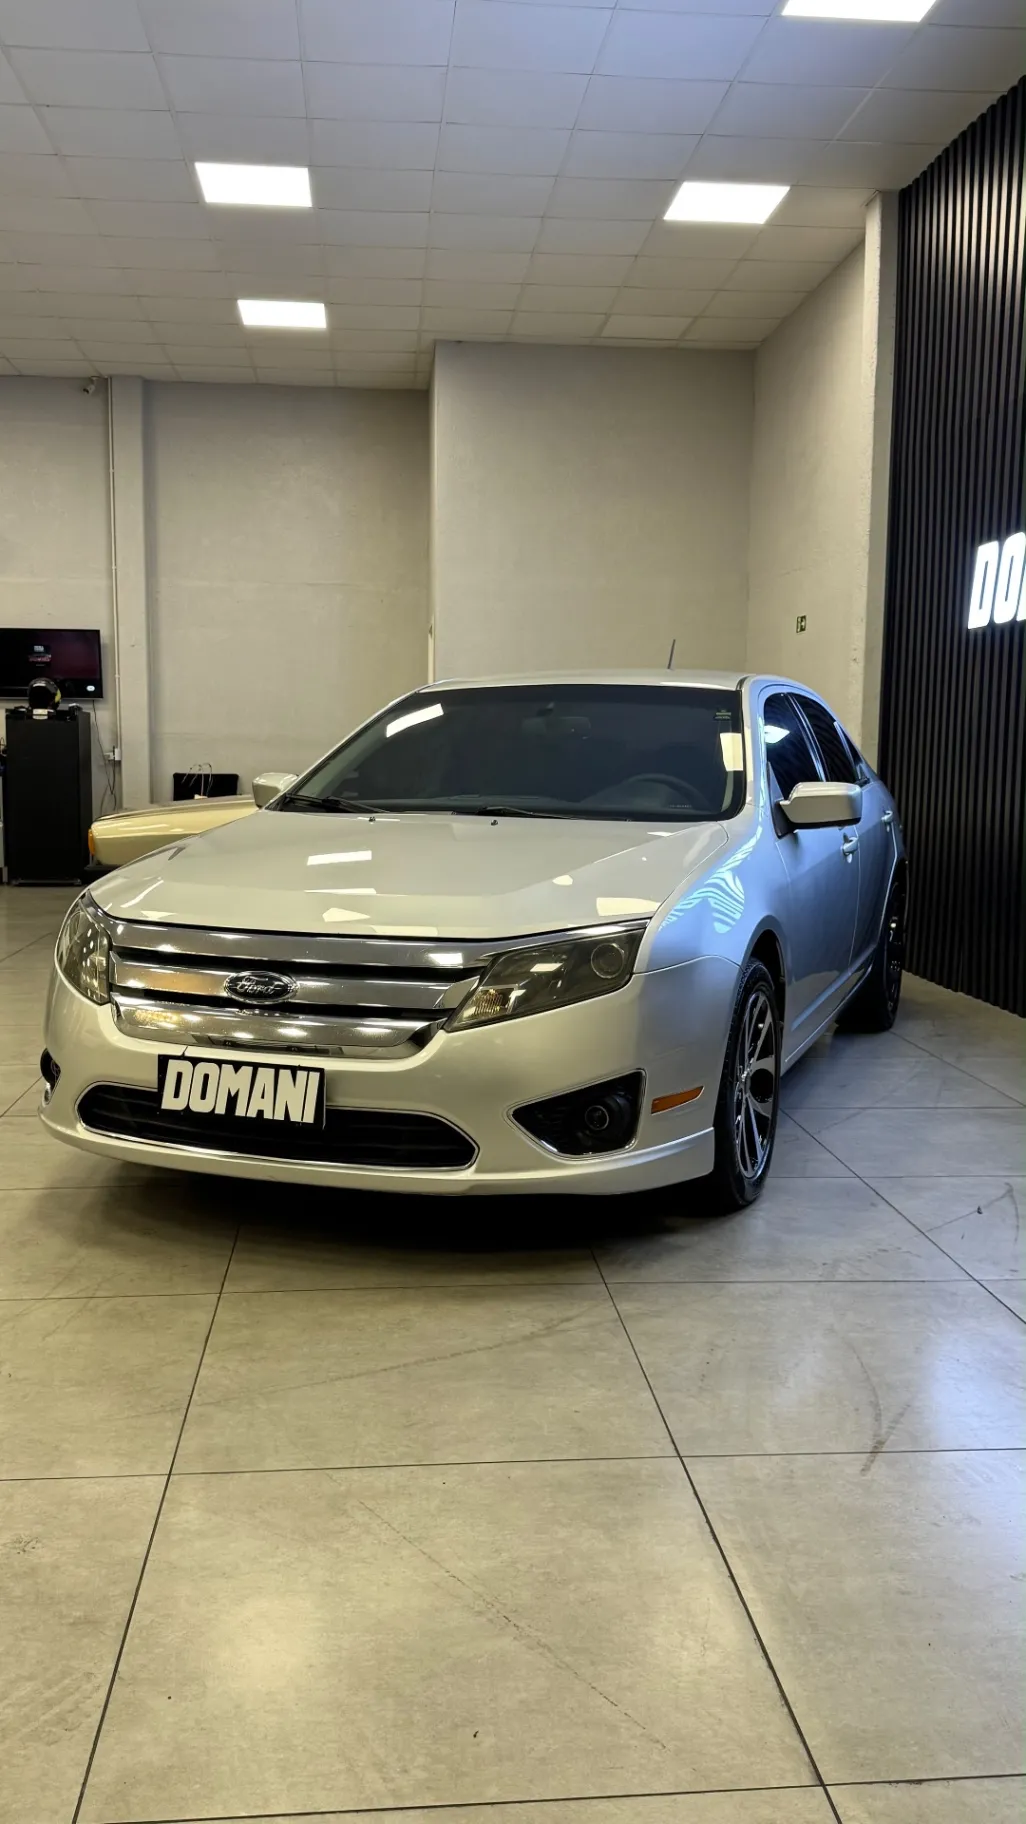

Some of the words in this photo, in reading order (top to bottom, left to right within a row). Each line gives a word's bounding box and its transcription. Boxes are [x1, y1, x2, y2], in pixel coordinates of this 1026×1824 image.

[968, 532, 1026, 629] DO
[236, 975, 284, 995] Ford
[161, 1059, 320, 1123] DOMANI
